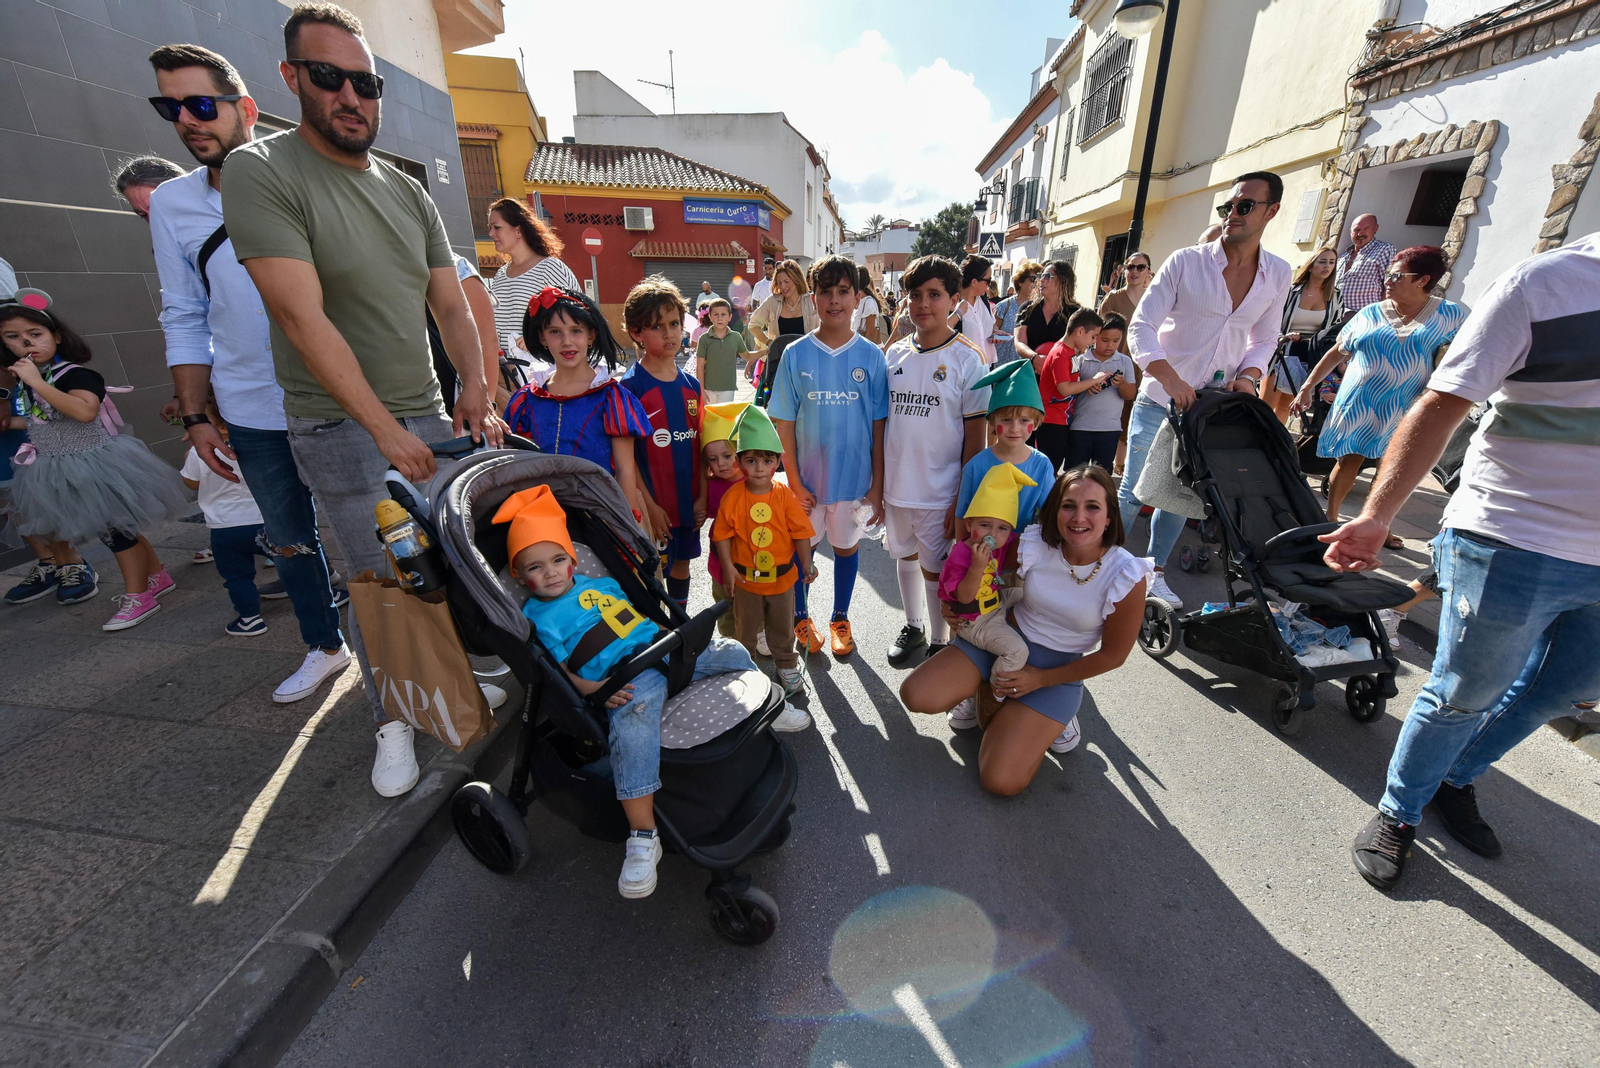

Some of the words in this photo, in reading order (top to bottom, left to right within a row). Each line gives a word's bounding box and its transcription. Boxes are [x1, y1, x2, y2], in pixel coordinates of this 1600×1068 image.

[727, 206, 748, 217] Curro
[807, 391, 859, 400] ETIHAD
[890, 390, 940, 407] Emirates
[894, 404, 905, 415] FLY
[904, 405, 930, 417] BETTER
